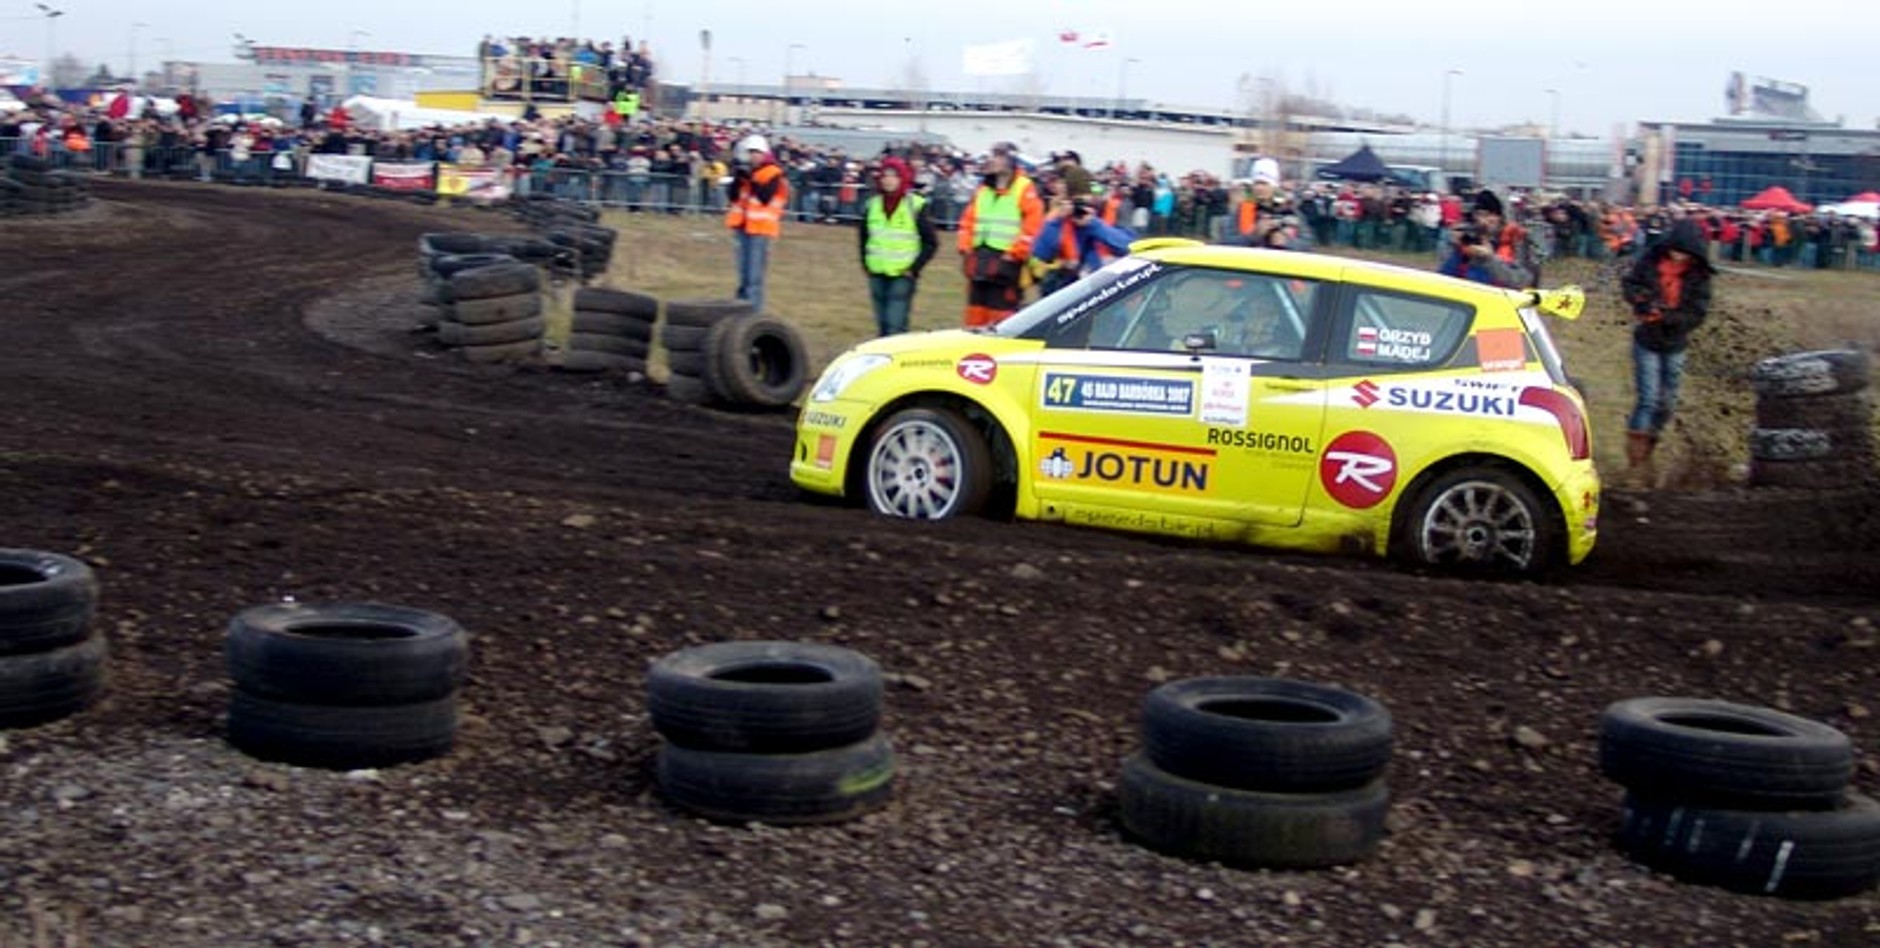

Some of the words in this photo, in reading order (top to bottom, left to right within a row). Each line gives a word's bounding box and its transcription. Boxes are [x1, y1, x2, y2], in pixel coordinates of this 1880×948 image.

[1377, 342, 1431, 361] MADEJ
[1048, 376, 1076, 403] 47
[1167, 386, 1190, 403] 2007
[1388, 387, 1516, 416] SUZUKI
[1207, 427, 1314, 453] ROSSIGNOL
[1077, 451, 1208, 491] JOTUN
[1326, 451, 1392, 493] R
